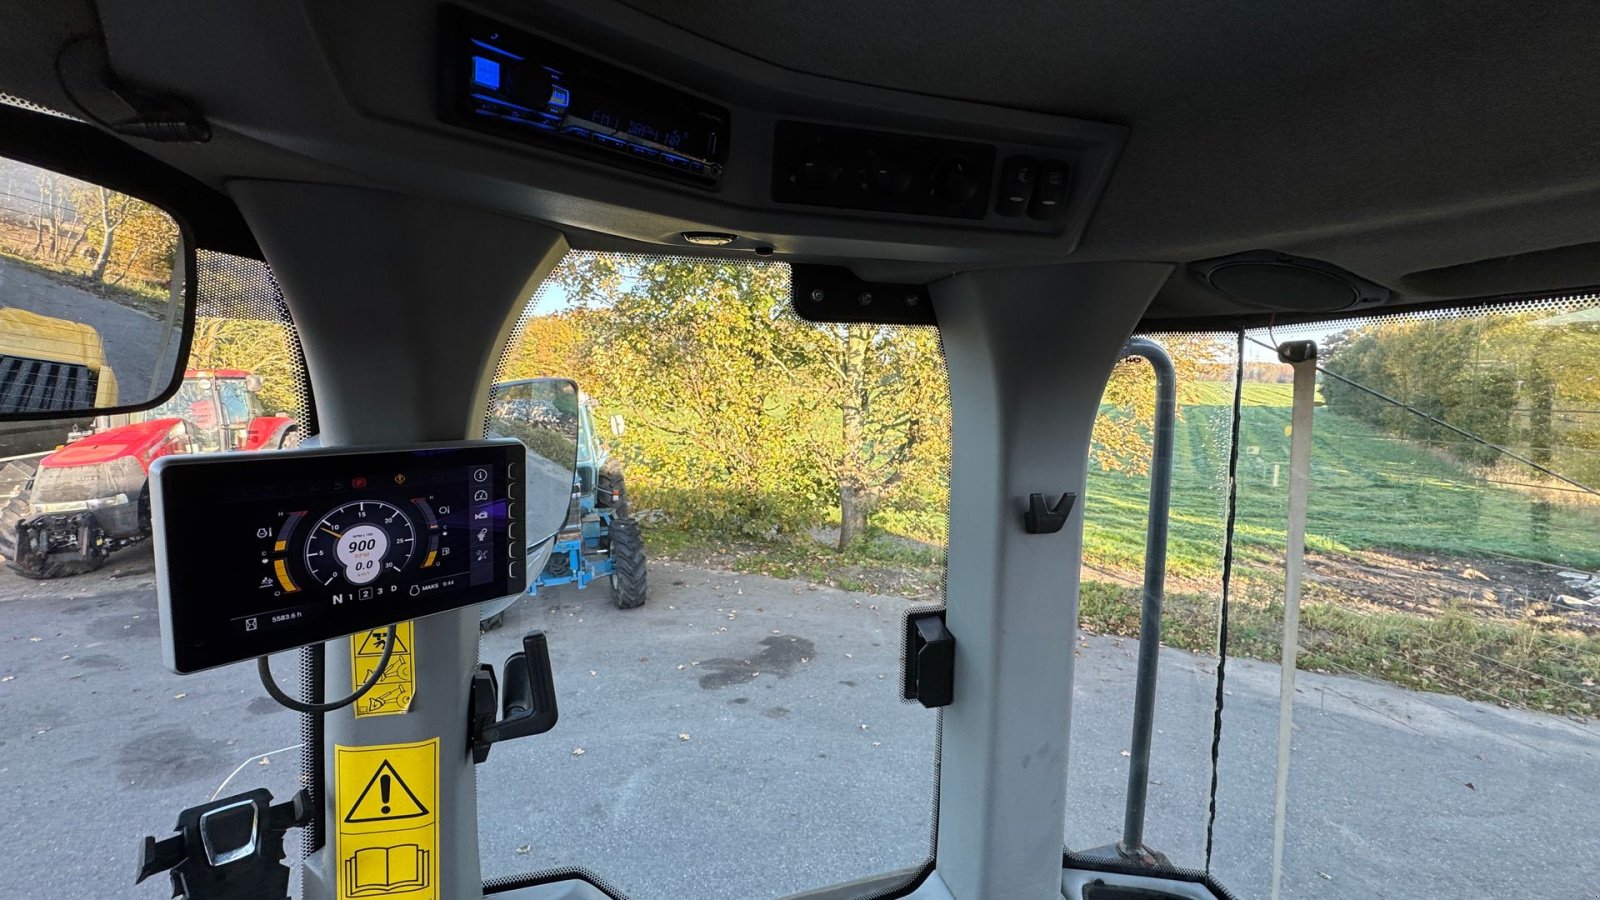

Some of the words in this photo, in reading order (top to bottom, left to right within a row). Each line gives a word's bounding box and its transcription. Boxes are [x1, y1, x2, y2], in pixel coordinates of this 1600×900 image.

[348, 538, 376, 553] 900
[355, 560, 373, 571] 0.0
[421, 583, 439, 591] MAKS
[332, 594, 343, 605] N
[363, 590, 369, 598] 2
[377, 587, 383, 595] 3
[271, 613, 296, 623] 5583.6
